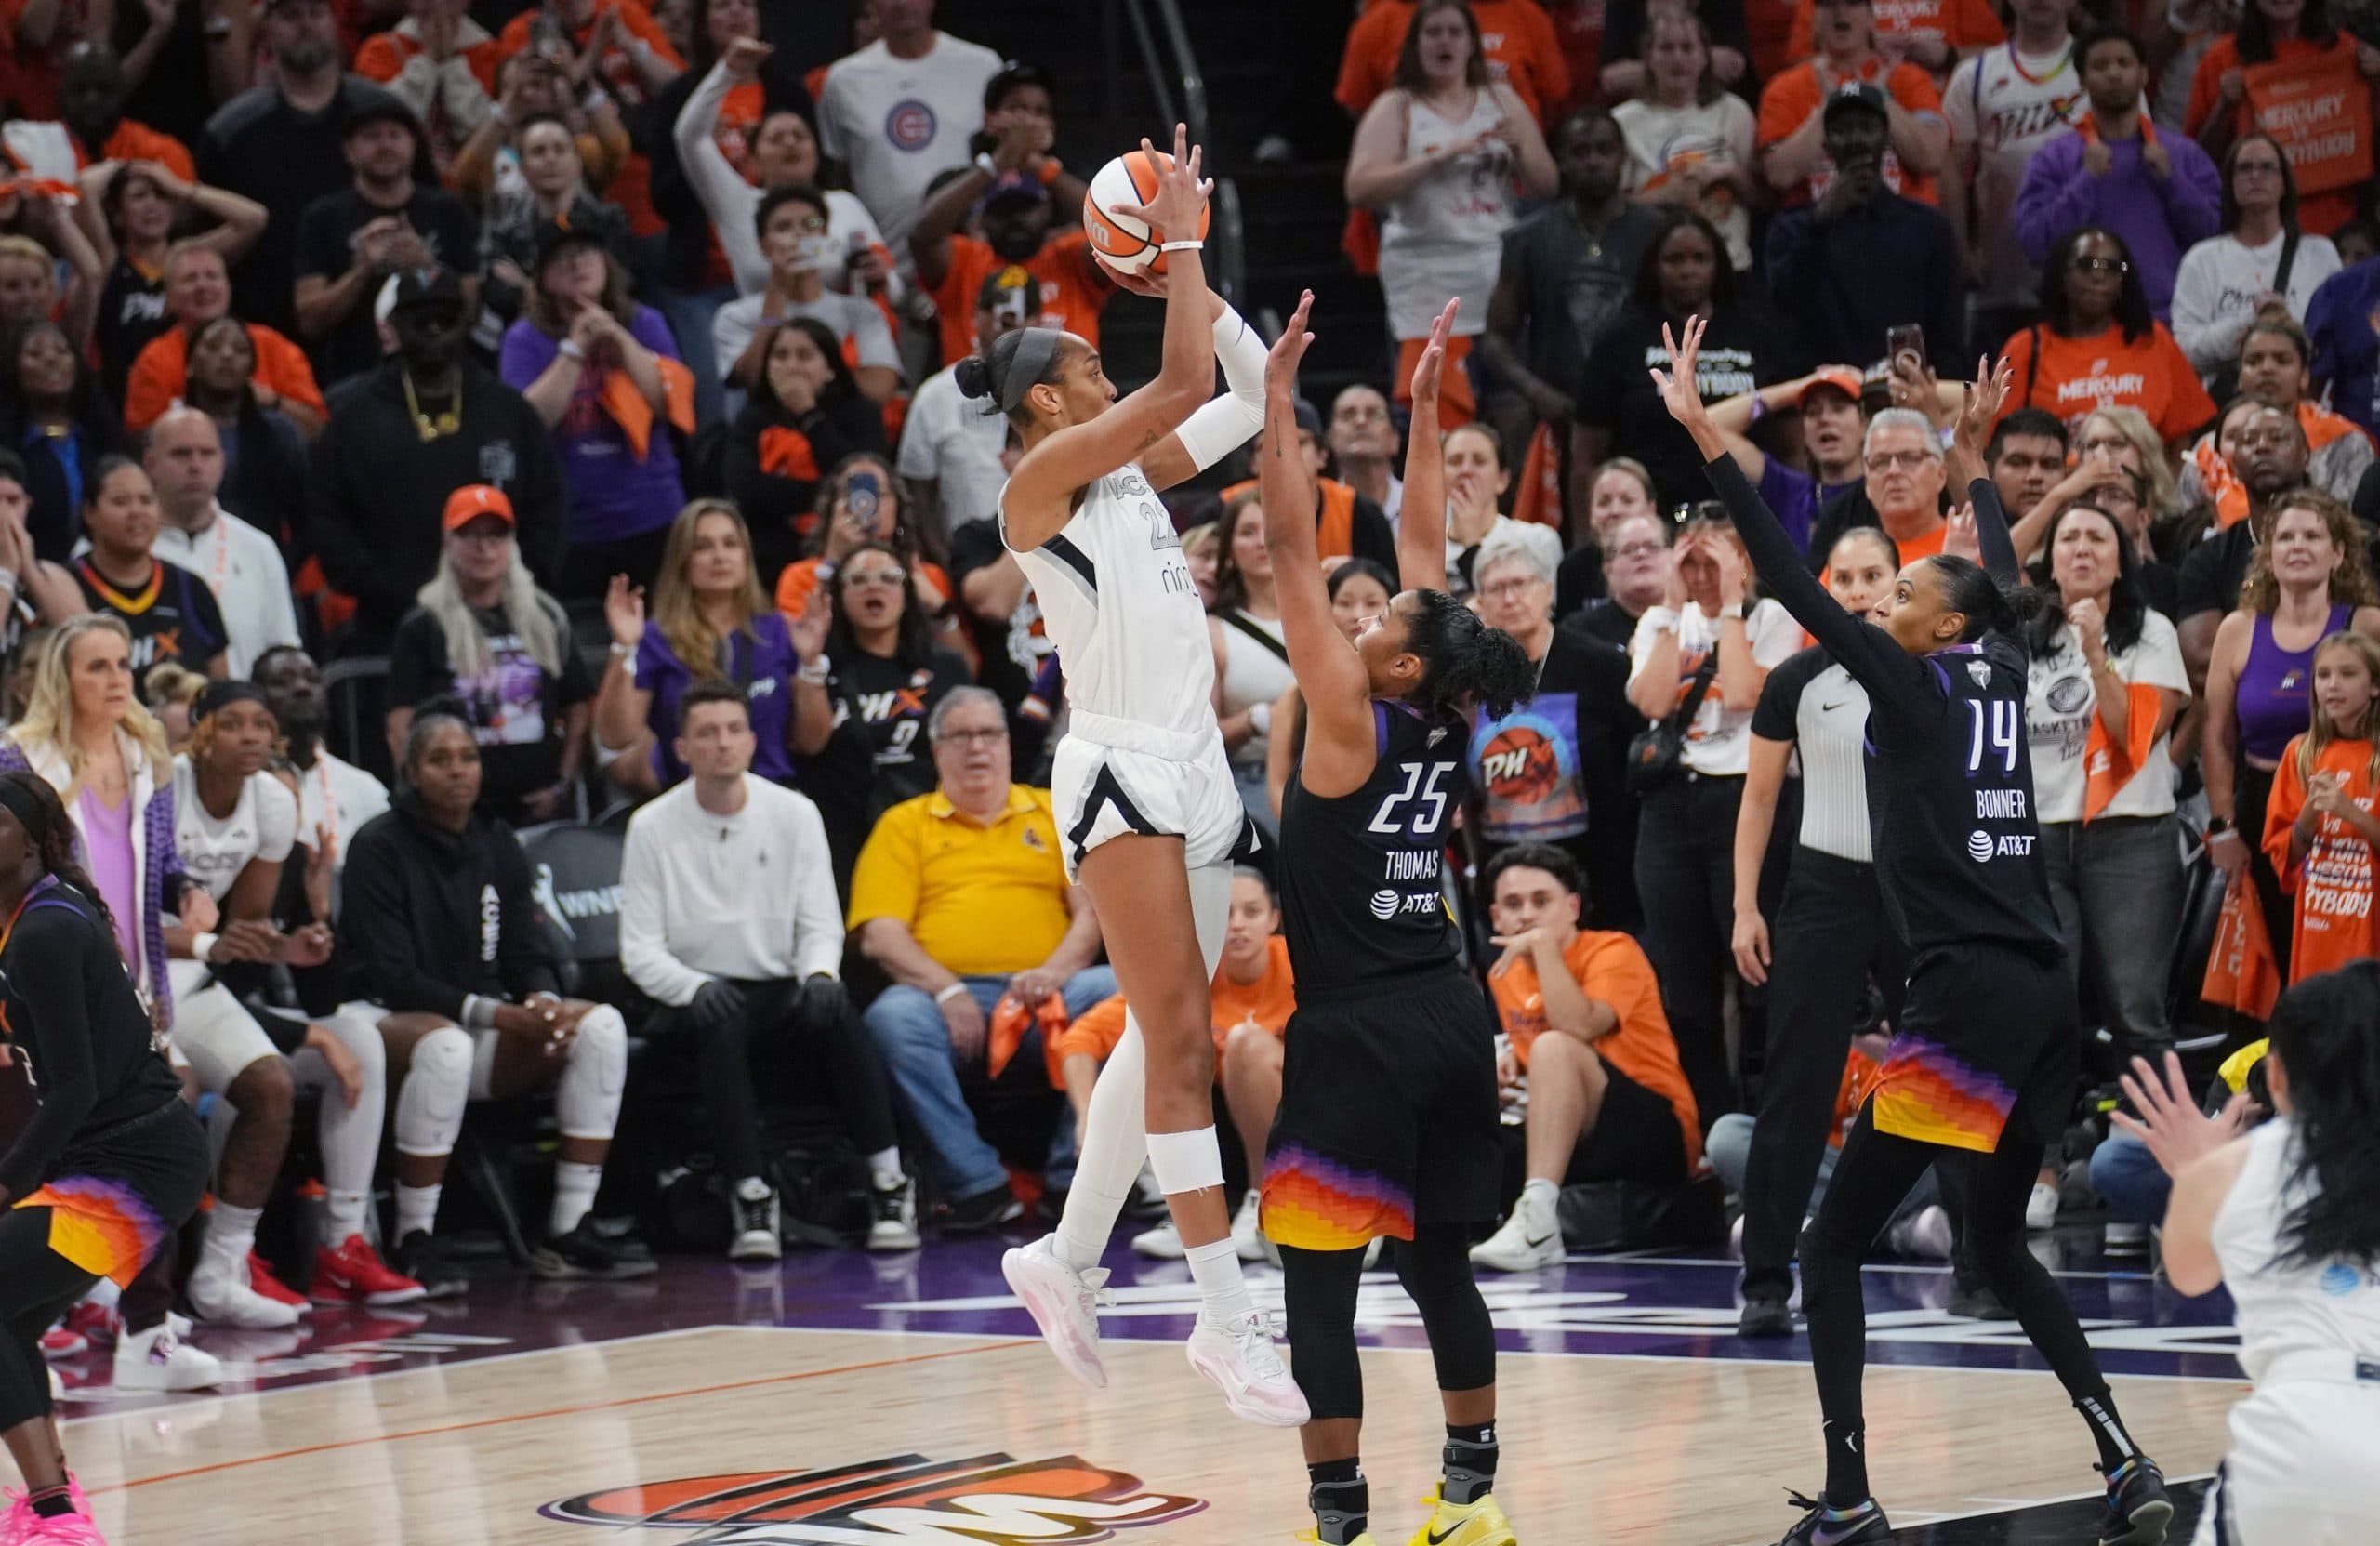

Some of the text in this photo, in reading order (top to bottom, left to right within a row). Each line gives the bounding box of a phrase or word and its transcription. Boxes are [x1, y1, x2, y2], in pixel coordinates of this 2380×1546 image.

[2057, 374, 2144, 403] MERCURY
[1161, 561, 1199, 598] rin
[1968, 699, 2017, 772] 14
[1368, 761, 1458, 834] 25
[1975, 789, 2027, 820] BONNER
[1996, 835, 2036, 856] AT&T
[1385, 848, 1439, 879] THOMAS
[1399, 892, 1440, 914] AT&T
[2304, 883, 2373, 919] RYBODY
